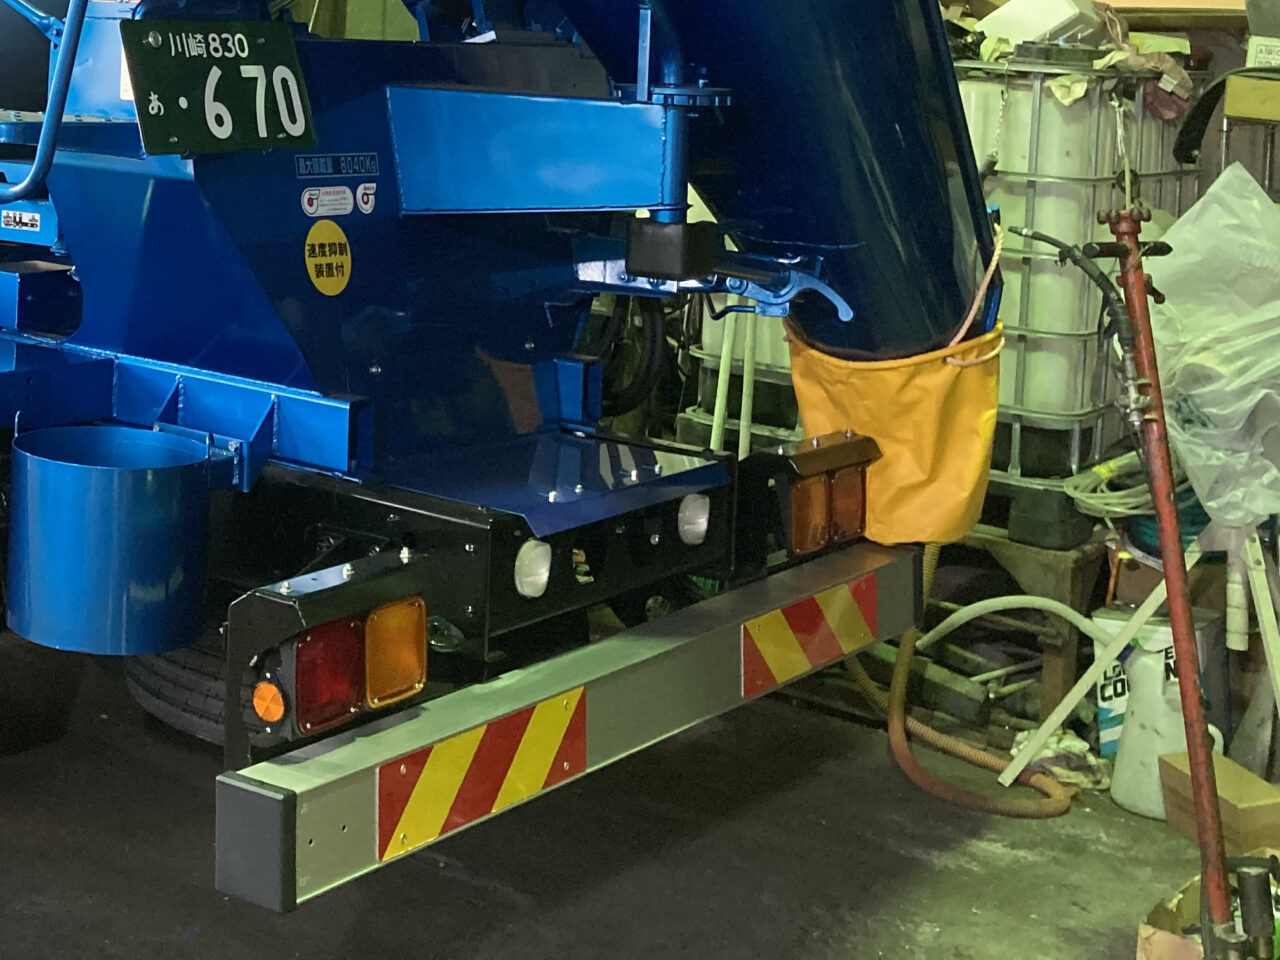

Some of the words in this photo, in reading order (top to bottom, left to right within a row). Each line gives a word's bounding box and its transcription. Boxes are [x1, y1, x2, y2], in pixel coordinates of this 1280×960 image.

[148, 91, 164, 116] あ
[307, 242, 349, 258] 速度抑制
[315, 261, 345, 279] 装置付
